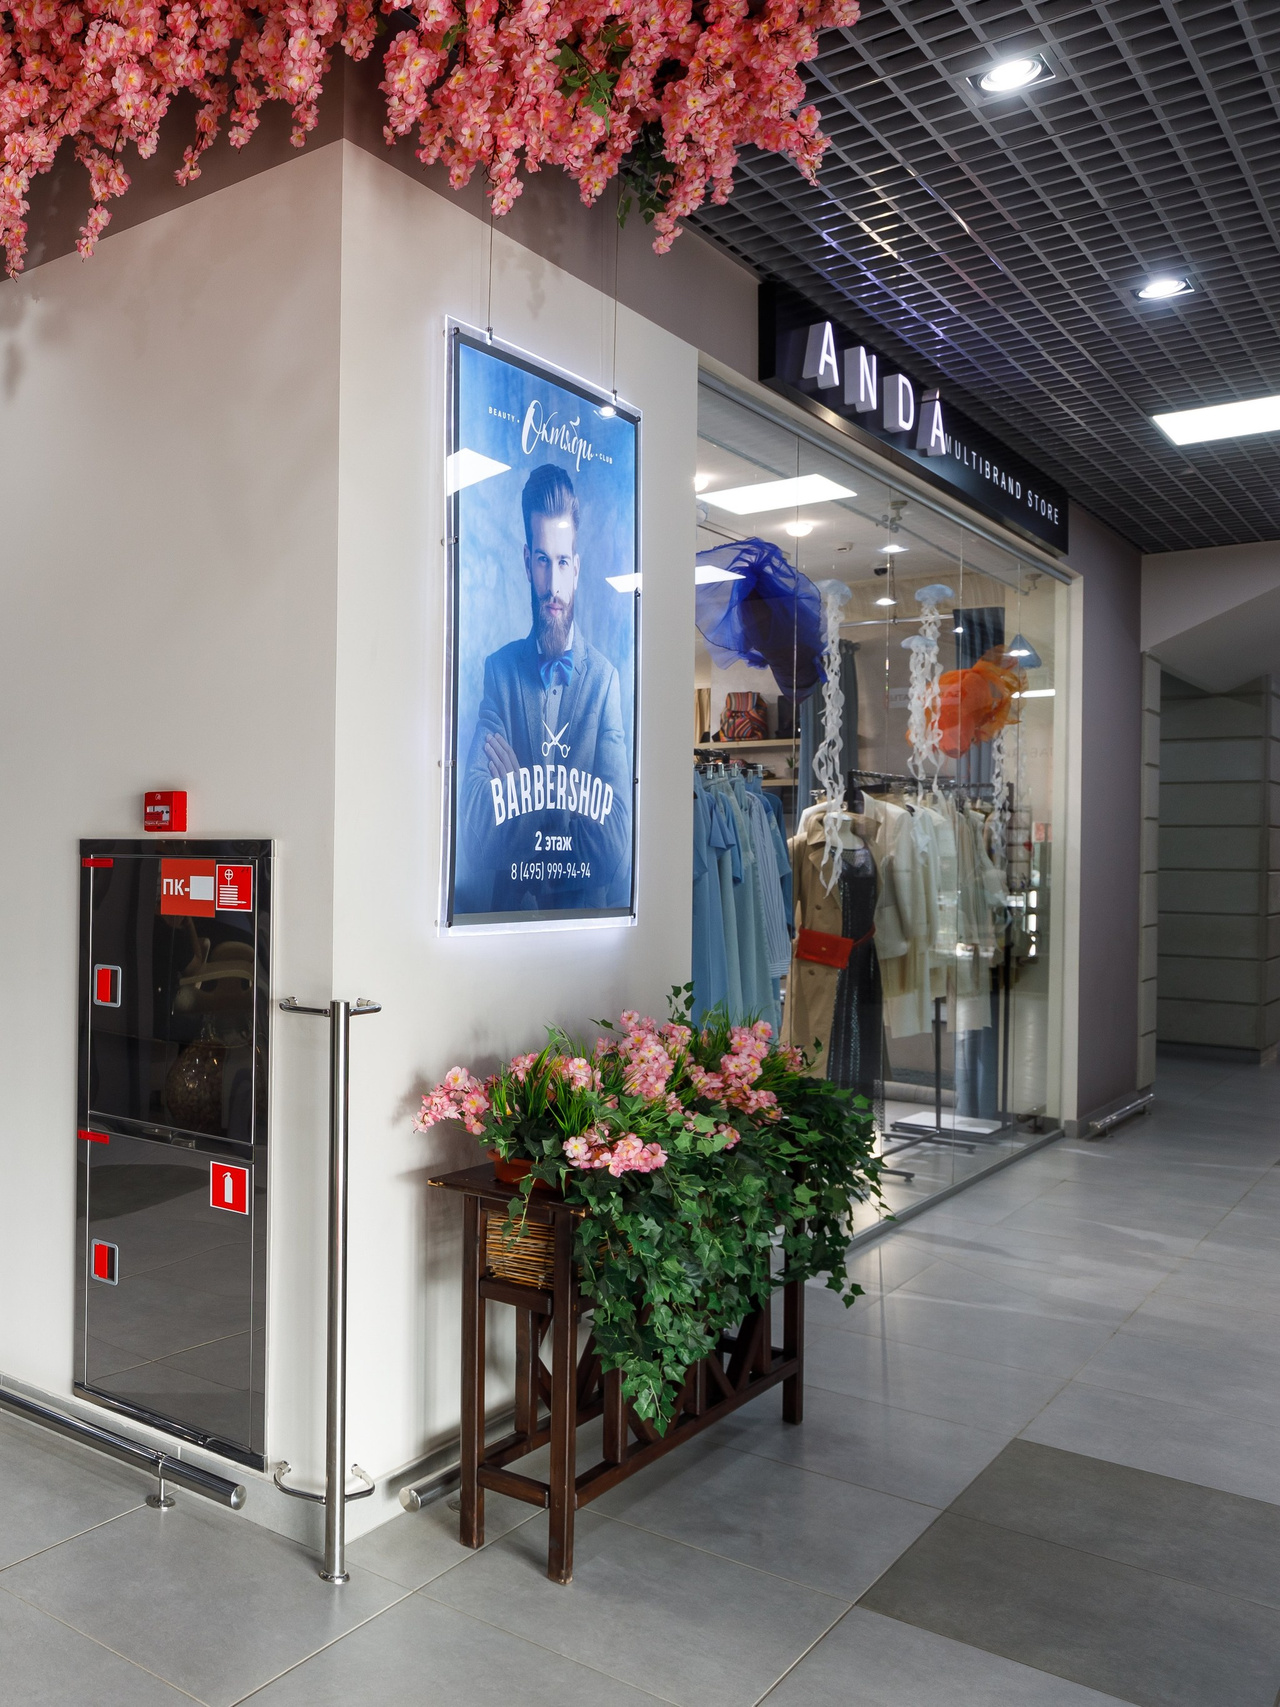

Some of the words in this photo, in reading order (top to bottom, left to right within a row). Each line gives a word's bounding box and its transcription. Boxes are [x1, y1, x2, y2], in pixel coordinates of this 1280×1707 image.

[488, 406, 516, 423] BEAUTY
[521, 399, 594, 473] Октябрь
[599, 453, 613, 465] CLUB
[944, 432, 1022, 500] MULTIBRAND
[1027, 490, 1059, 525] STORE
[490, 764, 614, 827] BARBERSHOP
[534, 831, 543, 851] 2
[544, 836, 572, 851] этаж
[162, 878, 190, 896] ПК-
[510, 862, 518, 880] 8
[520, 861, 545, 881] (495)
[546, 862, 591, 880] 999-94-94
